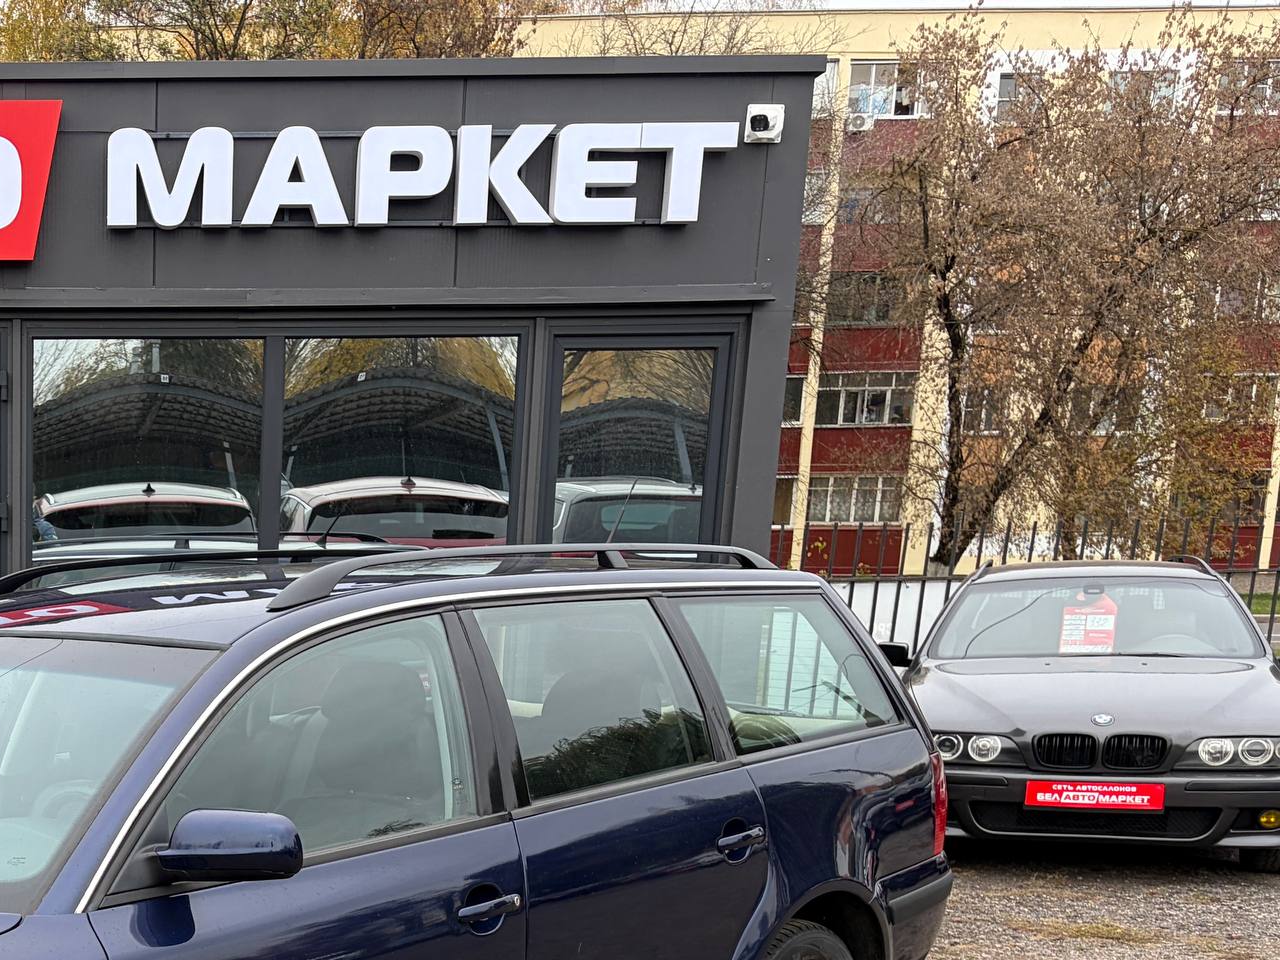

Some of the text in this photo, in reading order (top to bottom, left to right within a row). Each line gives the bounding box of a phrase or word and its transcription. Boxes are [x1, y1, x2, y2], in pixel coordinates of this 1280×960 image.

[106, 121, 740, 229] МАРКЕТ
[1036, 792, 1150, 804] БЕЛ АВТО МАРКЕТ
